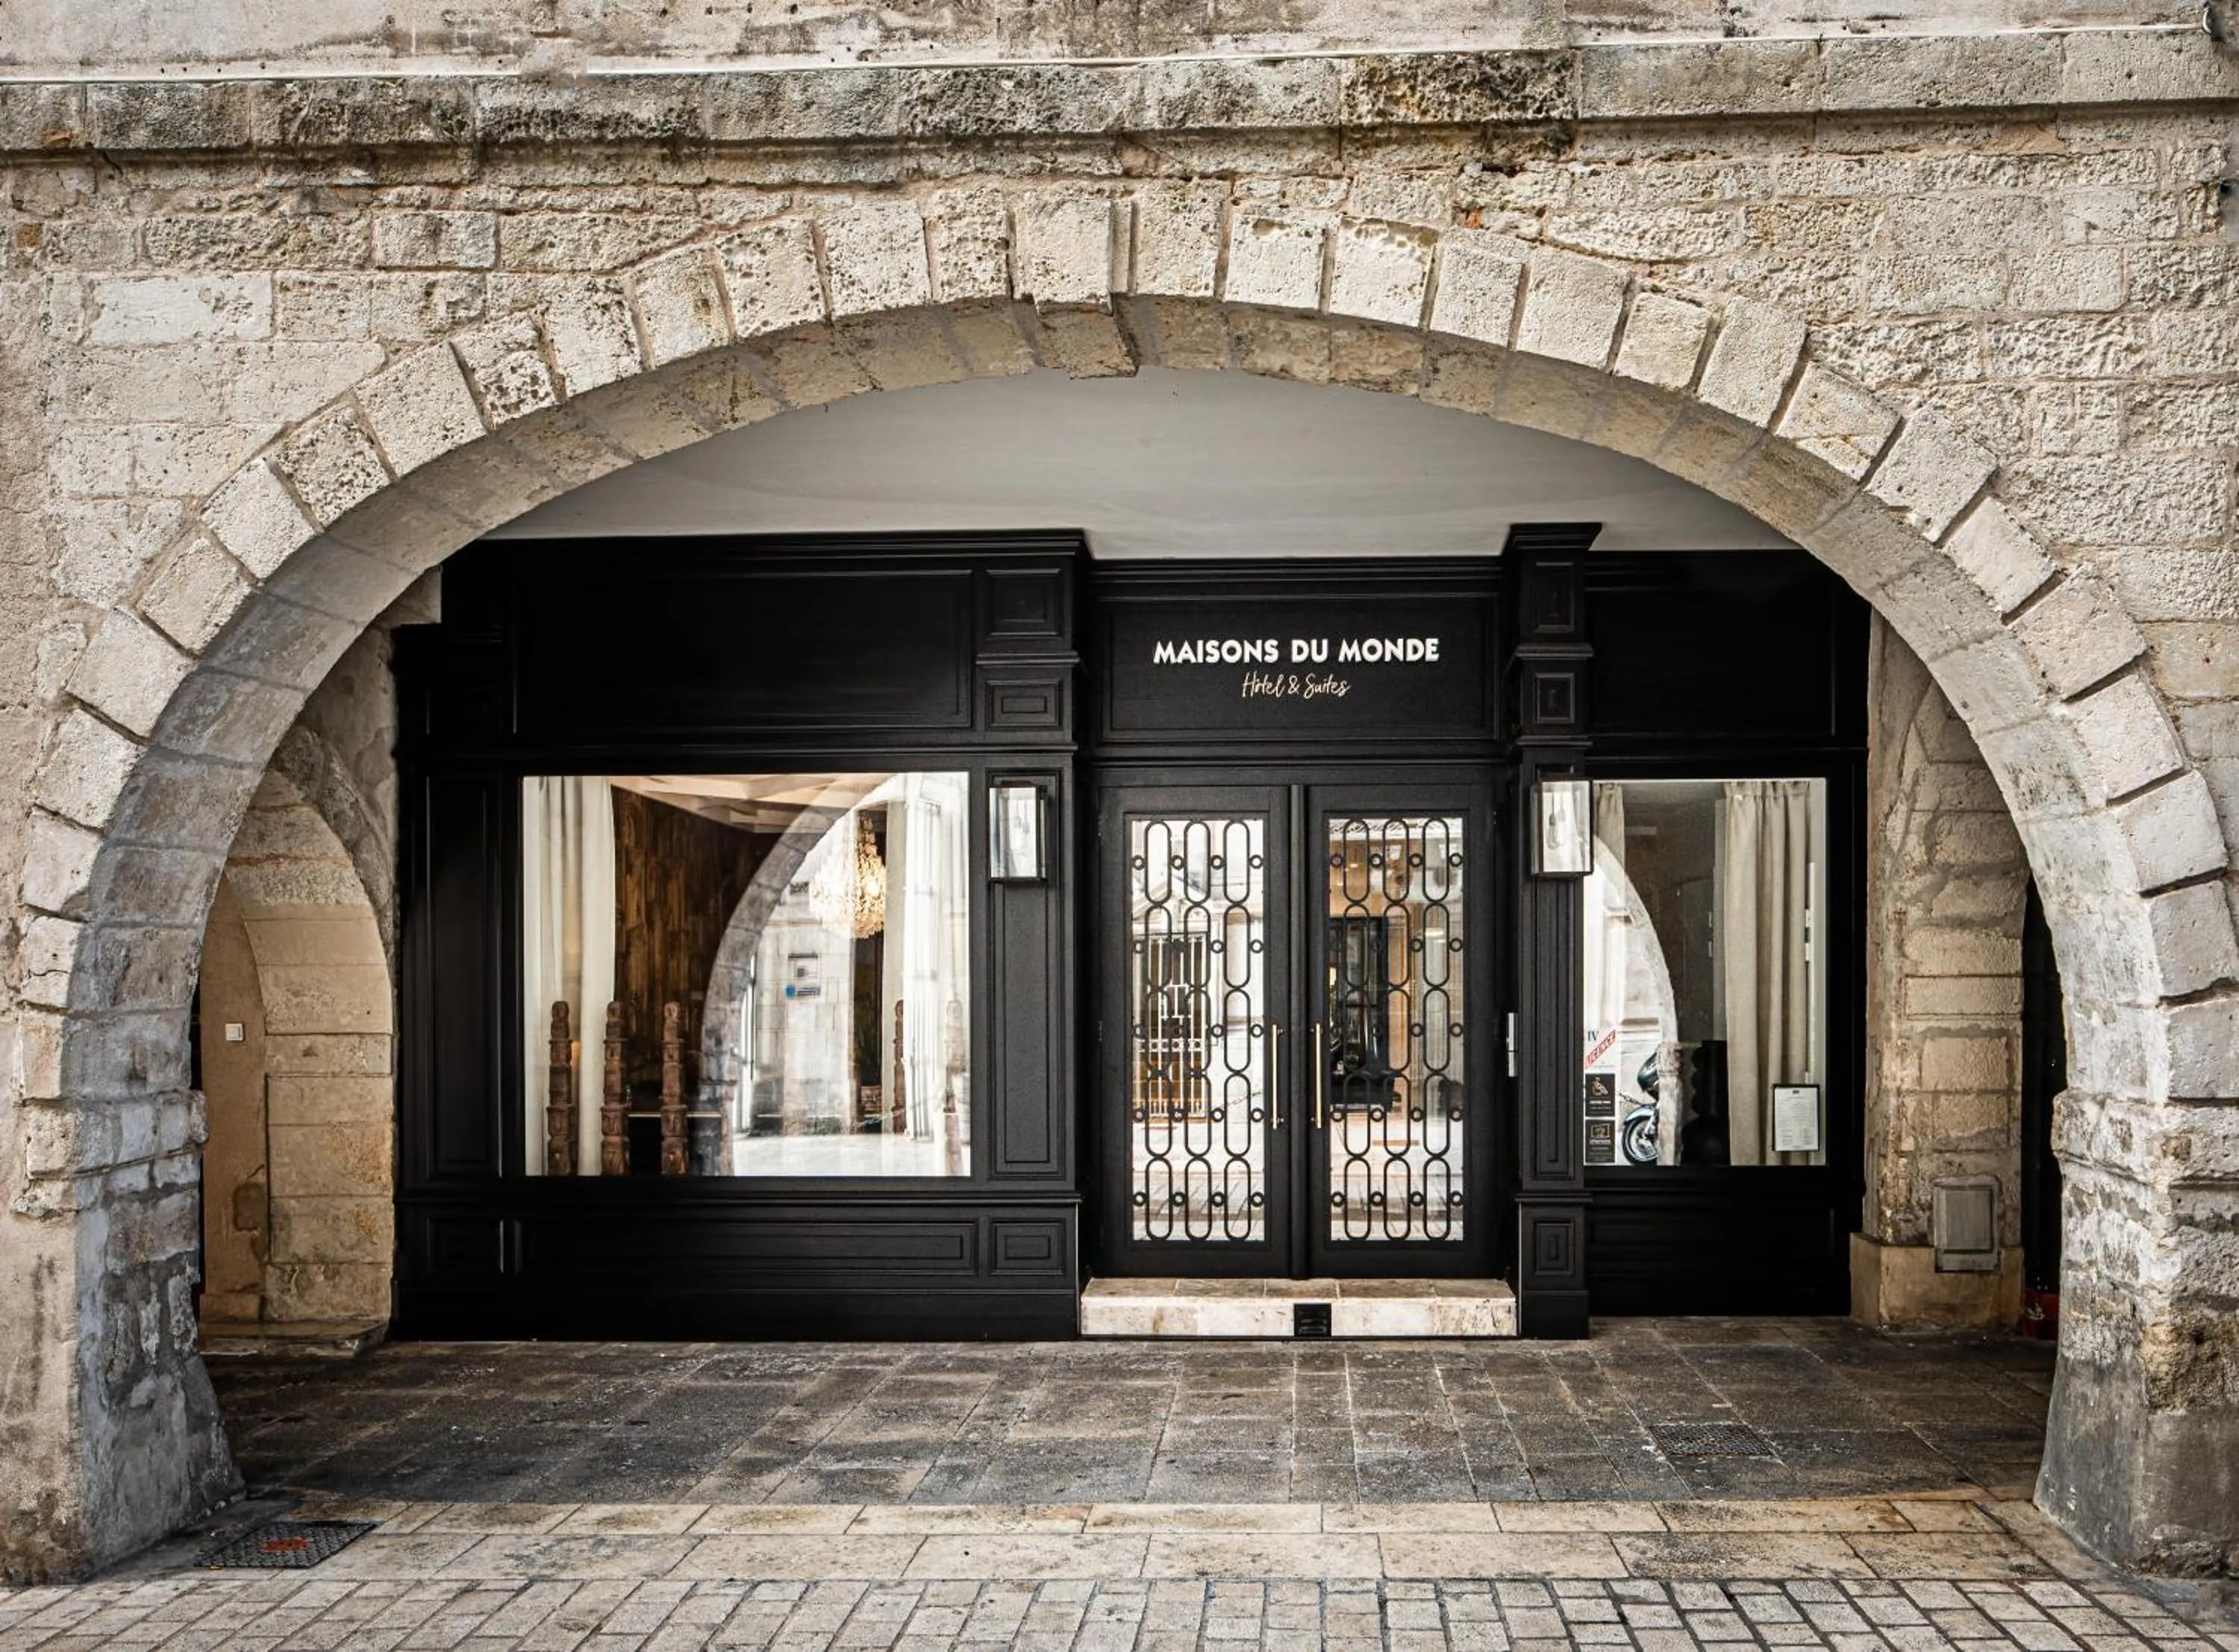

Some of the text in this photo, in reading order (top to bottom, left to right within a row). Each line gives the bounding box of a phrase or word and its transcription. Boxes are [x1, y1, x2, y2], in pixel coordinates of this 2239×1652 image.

[1153, 638, 1440, 663] MAISONS DU MONDE
[1287, 675, 1300, 695] &
[1304, 672, 1351, 698] Suites
